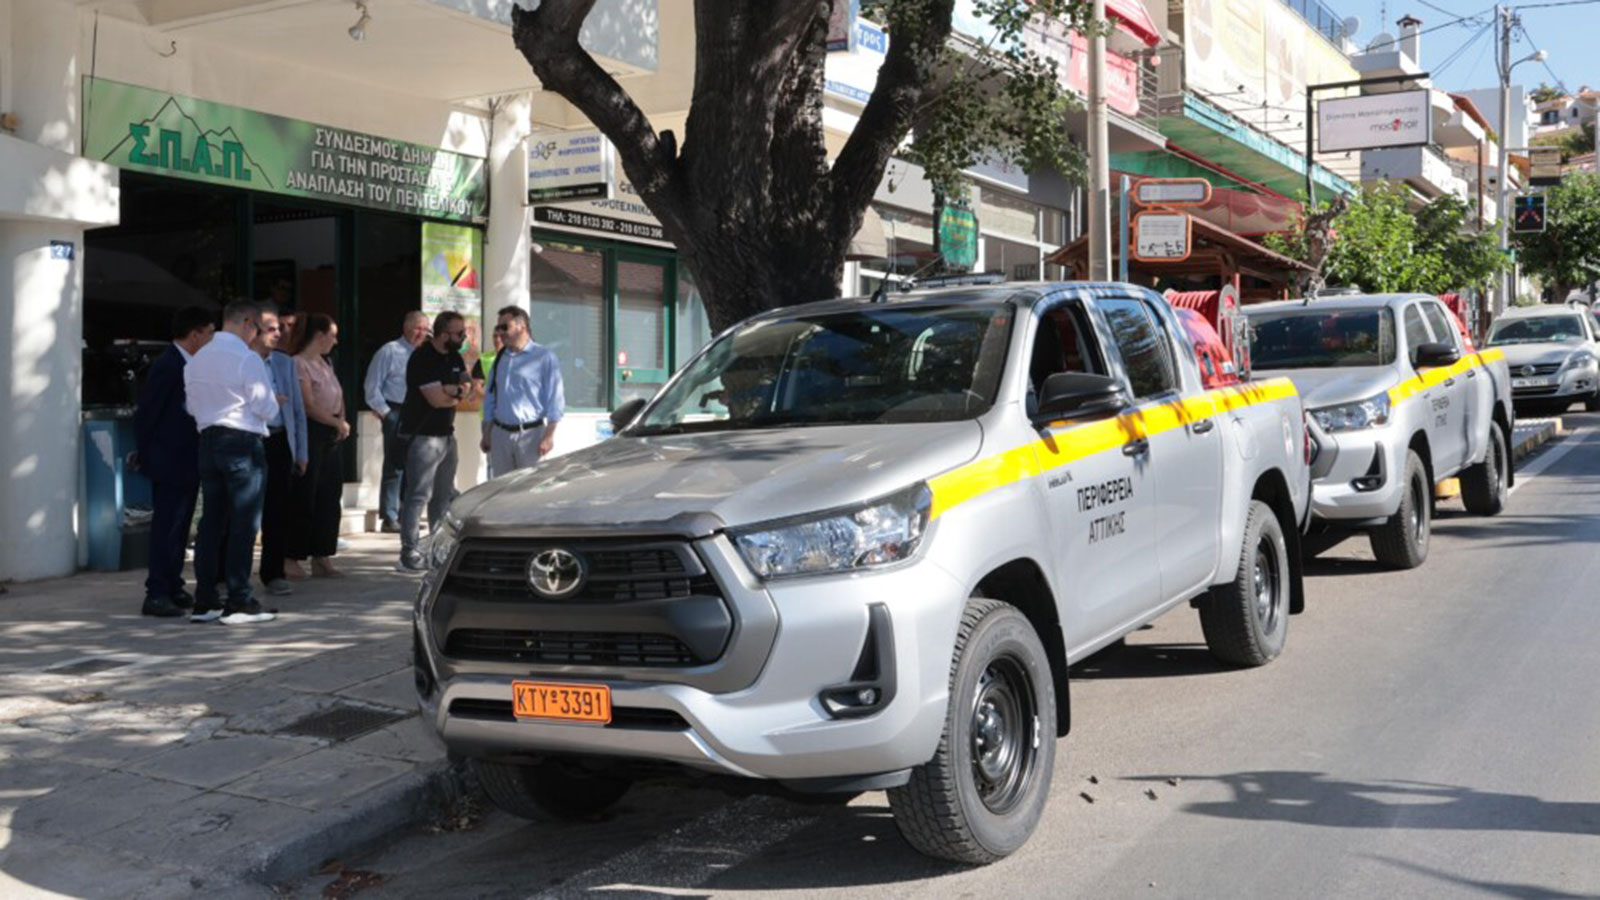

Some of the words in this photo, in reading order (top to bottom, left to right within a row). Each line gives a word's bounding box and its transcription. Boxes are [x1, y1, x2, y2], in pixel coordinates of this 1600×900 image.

[128, 122, 251, 181] Σ.Π.Α.Π.
[315, 127, 398, 160] ΣΥΝΔΕΣΜΟΣ
[311, 150, 335, 171] ΓΙΑ
[338, 154, 367, 177] ΤΗΝ
[286, 170, 364, 199] ΑΝΑΠΛΑΣΗ
[367, 183, 393, 203] ΤΟΥ
[396, 188, 473, 216] ΠΕΝΤΕΛΙΚΟΥ
[567, 212, 581, 225] 210
[1077, 476, 1133, 512] ΠΕΡΙΦΕΡΕΙΑ
[1089, 510, 1126, 545] ΑΤΤΙΚΗΣ
